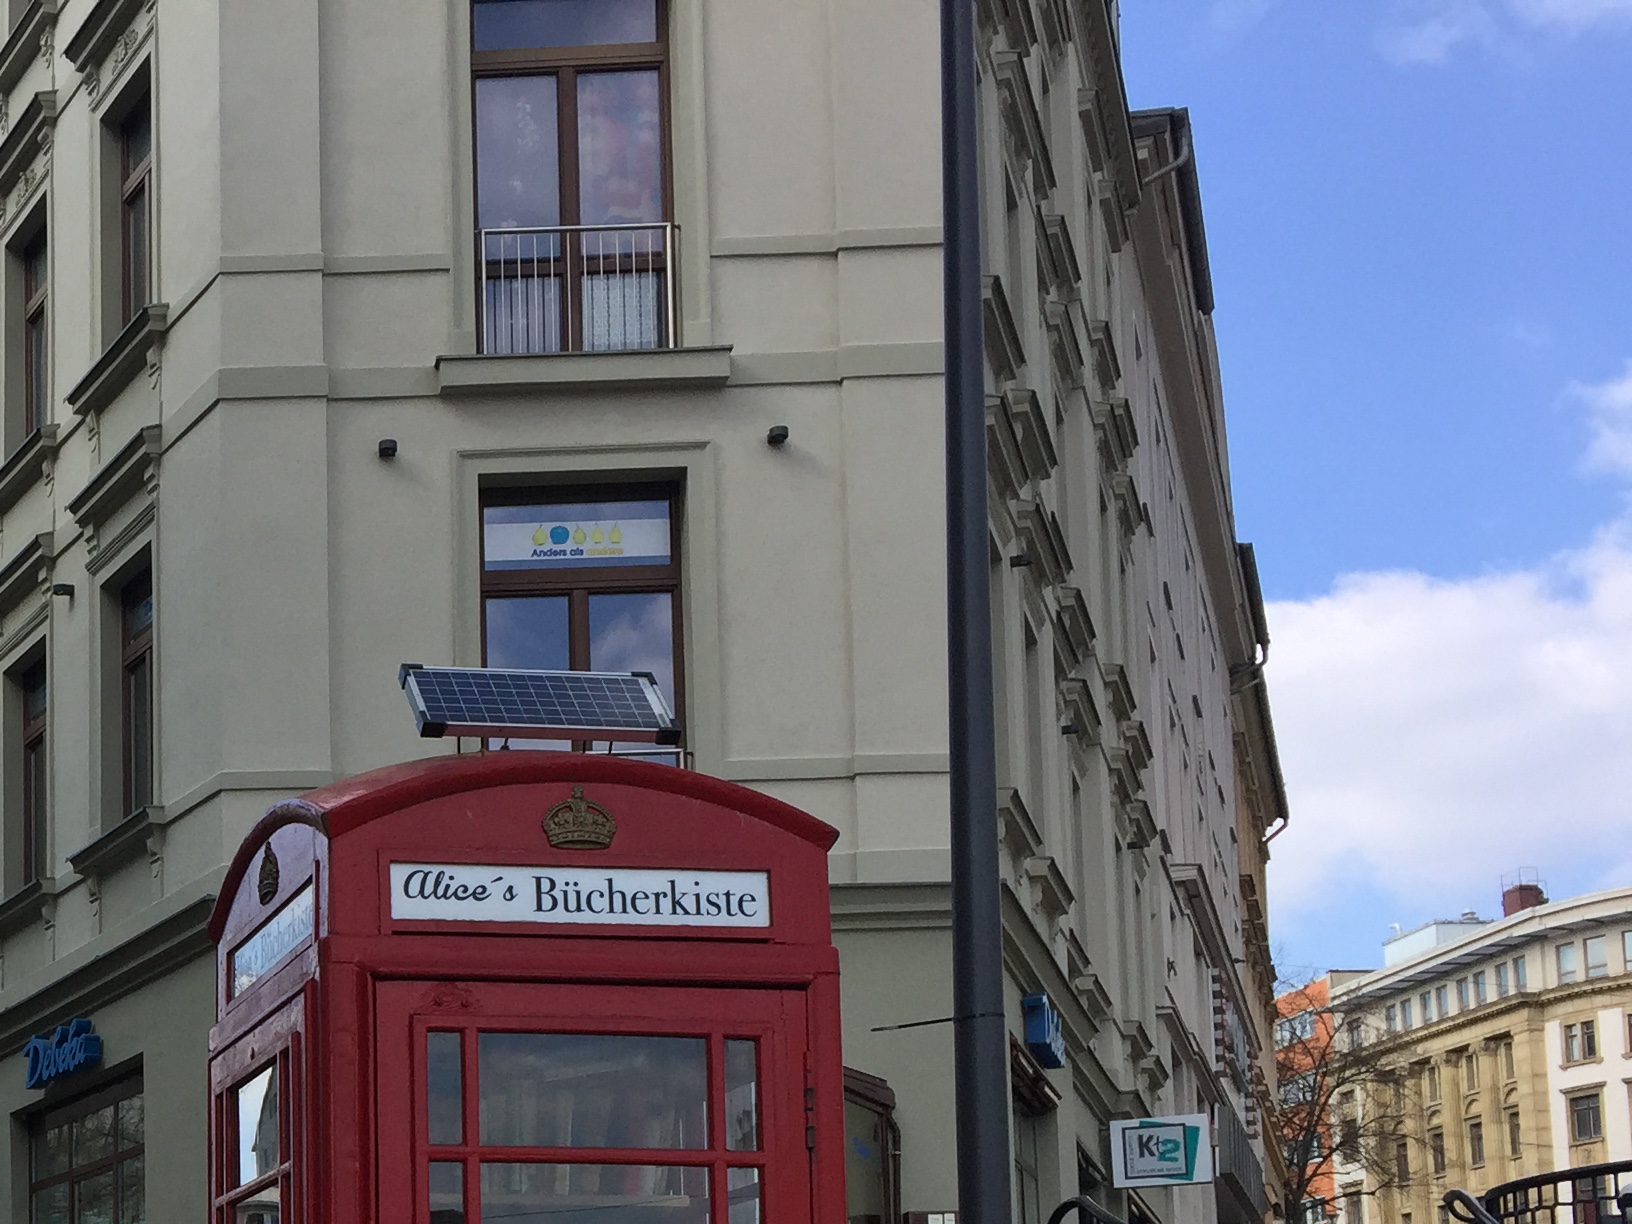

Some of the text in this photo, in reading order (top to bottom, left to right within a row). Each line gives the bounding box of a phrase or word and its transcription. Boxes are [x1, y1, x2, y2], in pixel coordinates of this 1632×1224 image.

[531, 548, 567, 557] Anders
[532, 875, 758, 917] Bücherkiste
[21, 1017, 86, 1089] Debeka
